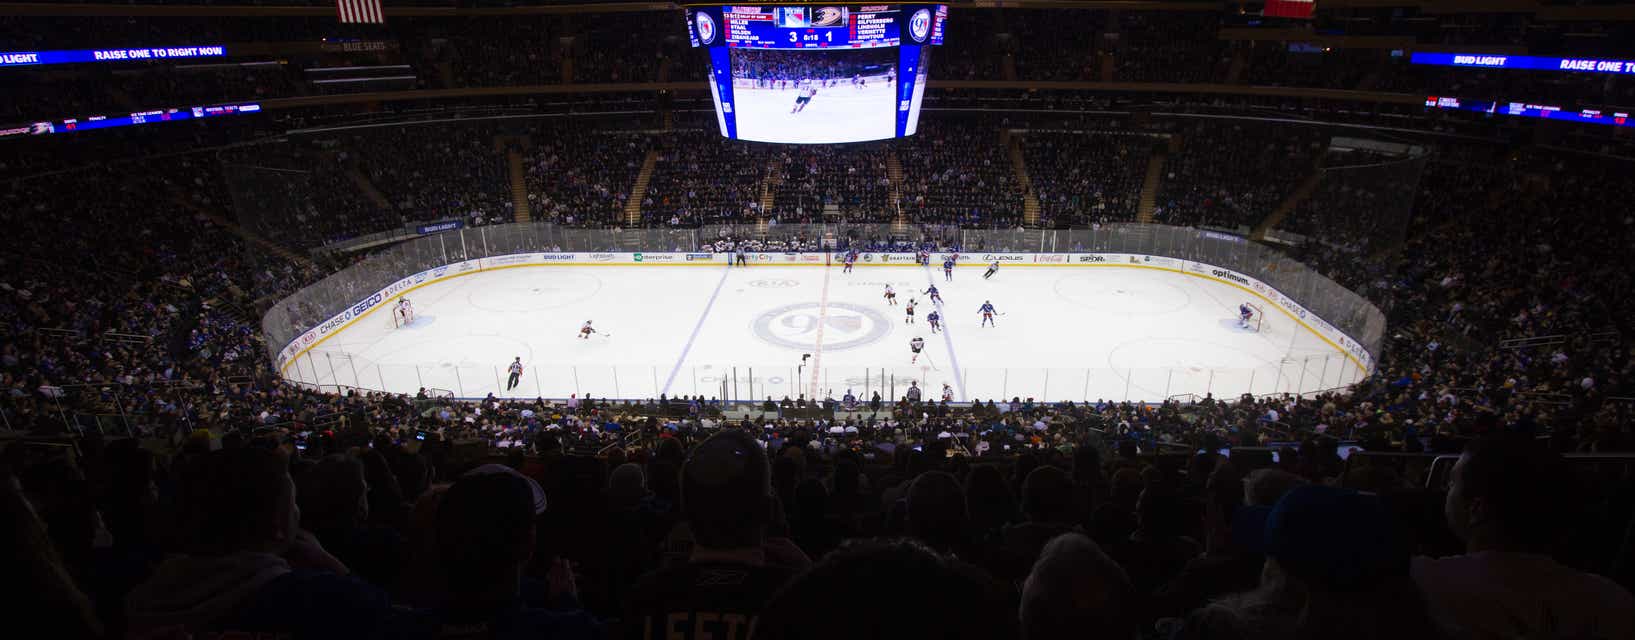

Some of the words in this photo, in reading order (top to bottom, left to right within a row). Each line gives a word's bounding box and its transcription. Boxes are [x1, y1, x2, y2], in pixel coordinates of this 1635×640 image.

[789, 32, 798, 42] 3
[826, 31, 832, 42] 1
[4, 54, 38, 64] LIGHT
[94, 50, 128, 60] RAISE
[129, 49, 150, 60] ONE
[152, 48, 167, 58] TO
[168, 48, 198, 58] RIGHT
[200, 46, 222, 56] NOW
[1454, 56, 1475, 64] BUD
[1476, 56, 1506, 66] LIGHT
[1560, 60, 1596, 70] RAISE
[1597, 61, 1621, 72] ONE
[389, 278, 412, 294] DELTA
[352, 293, 382, 316] GEICO
[320, 316, 345, 334] CHASE
